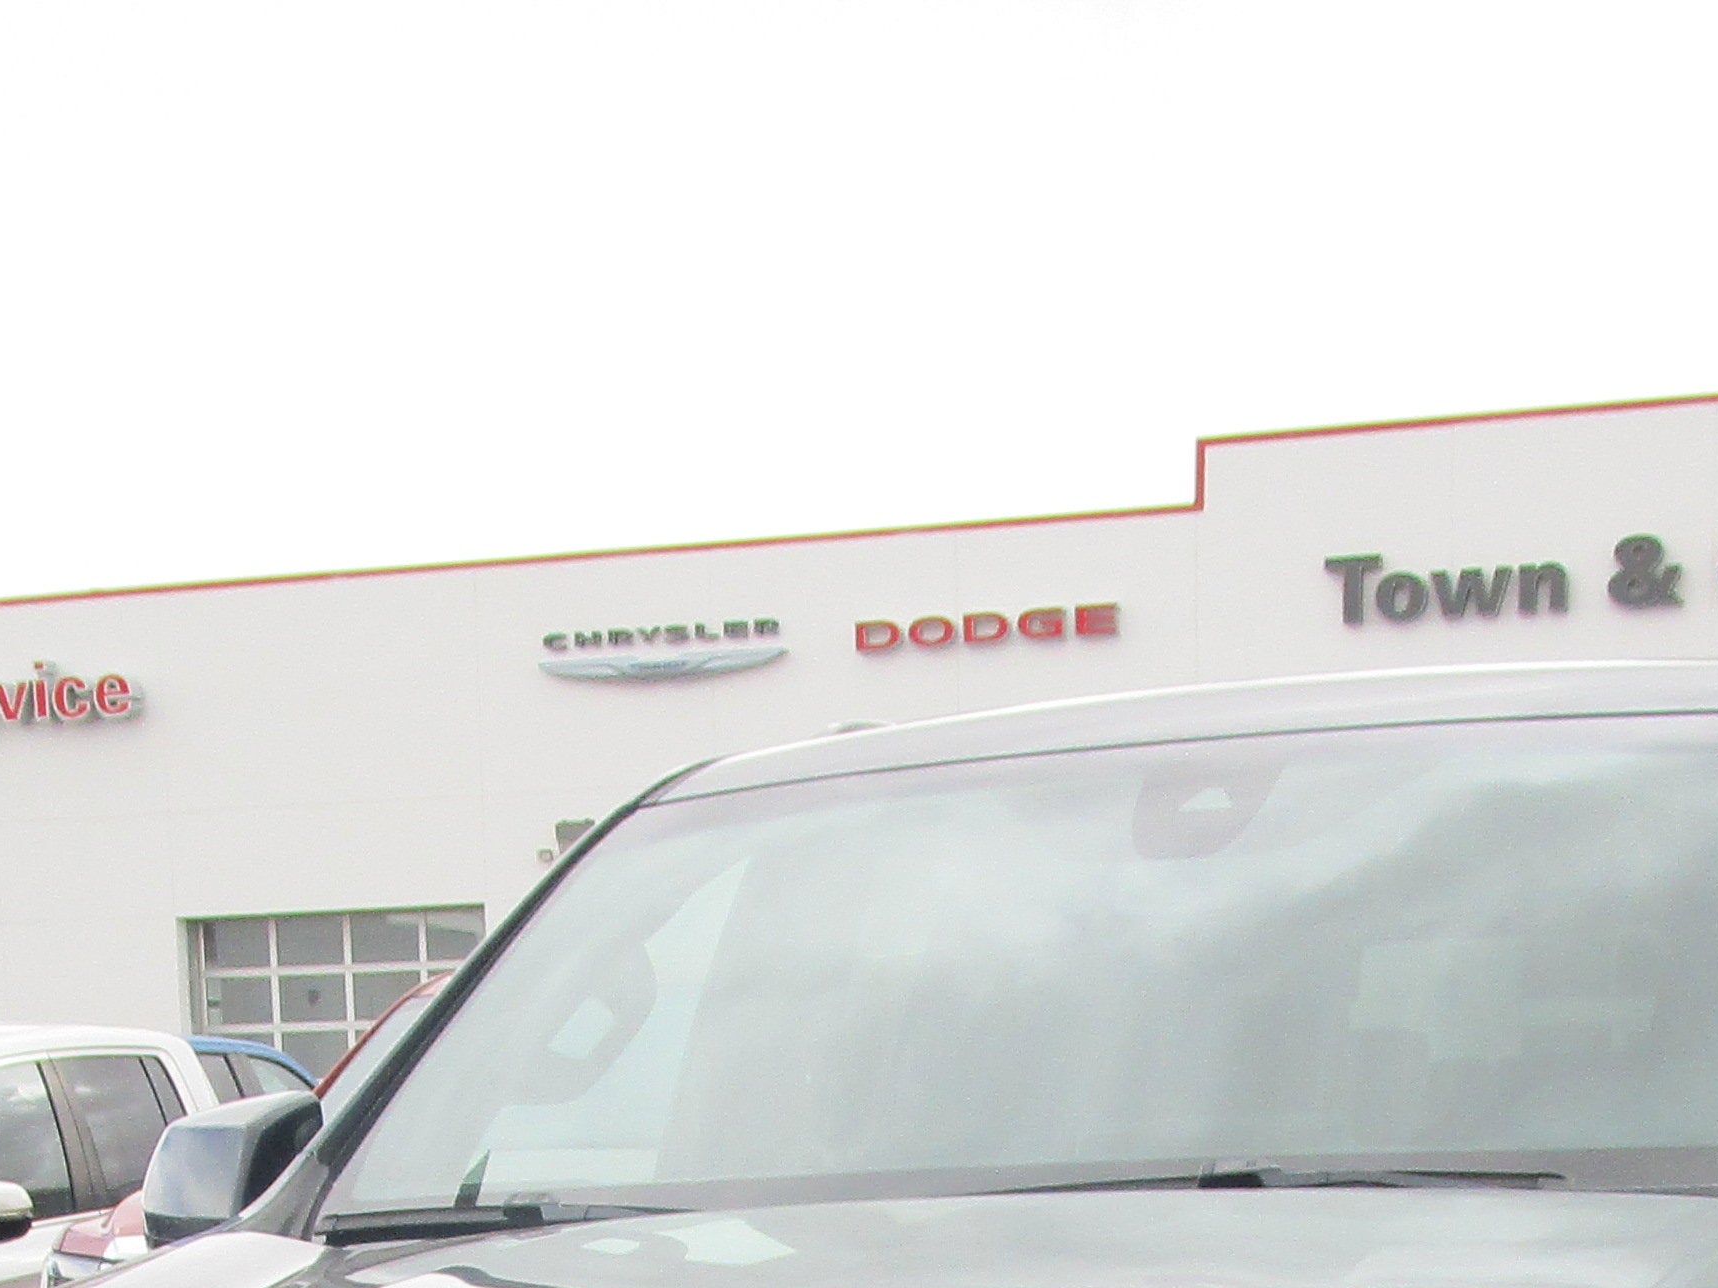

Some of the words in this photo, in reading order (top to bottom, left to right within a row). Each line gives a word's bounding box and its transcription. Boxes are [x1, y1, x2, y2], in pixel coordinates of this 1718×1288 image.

[1324, 553, 1570, 625] Town
[1607, 533, 1684, 607] &
[543, 617, 780, 651] CHRYSLER
[854, 602, 1121, 653] DODGE
